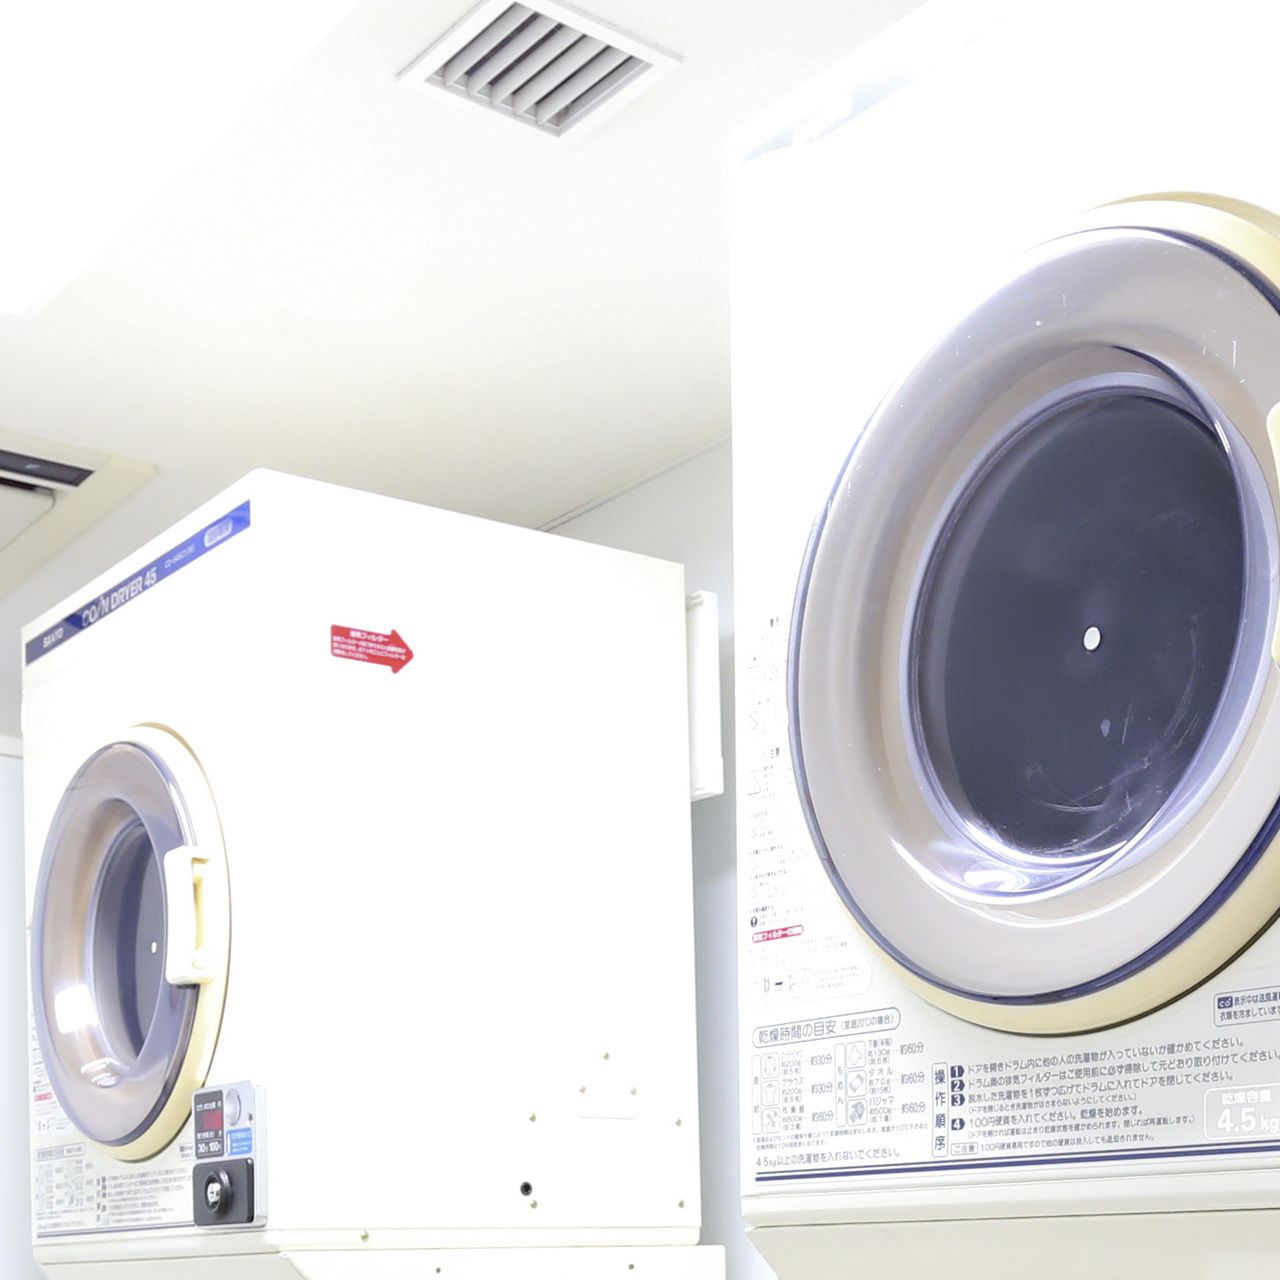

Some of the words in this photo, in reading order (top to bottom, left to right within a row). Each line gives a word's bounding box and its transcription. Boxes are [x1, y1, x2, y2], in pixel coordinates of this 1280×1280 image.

[110, 577, 143, 610] DRYER
[144, 567, 158, 587] 45
[758, 1019, 837, 1045] 乾燥時間の目安
[934, 1069, 946, 1151] 操作順序
